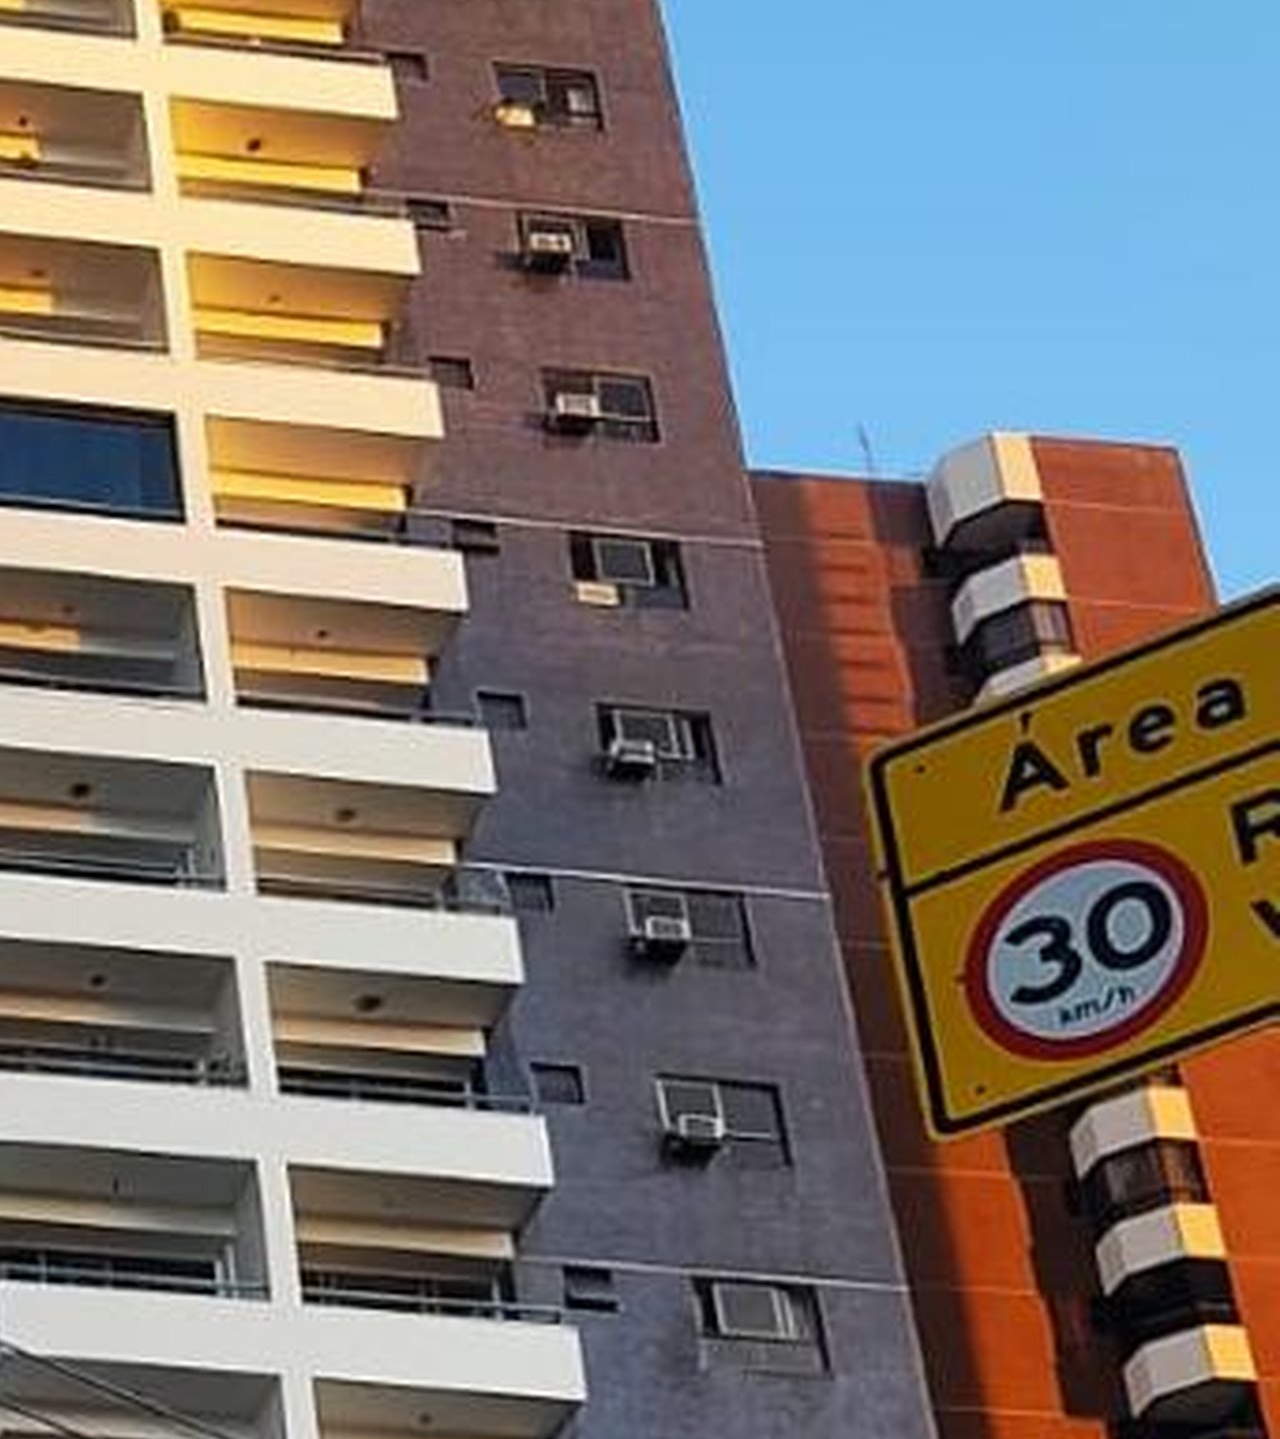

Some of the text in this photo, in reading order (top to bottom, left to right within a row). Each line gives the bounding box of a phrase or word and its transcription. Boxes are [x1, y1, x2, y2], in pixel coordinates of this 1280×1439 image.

[1000, 678, 1245, 812] Área
[1004, 881, 1173, 1004] 30
[1060, 986, 1136, 1025] km/h
